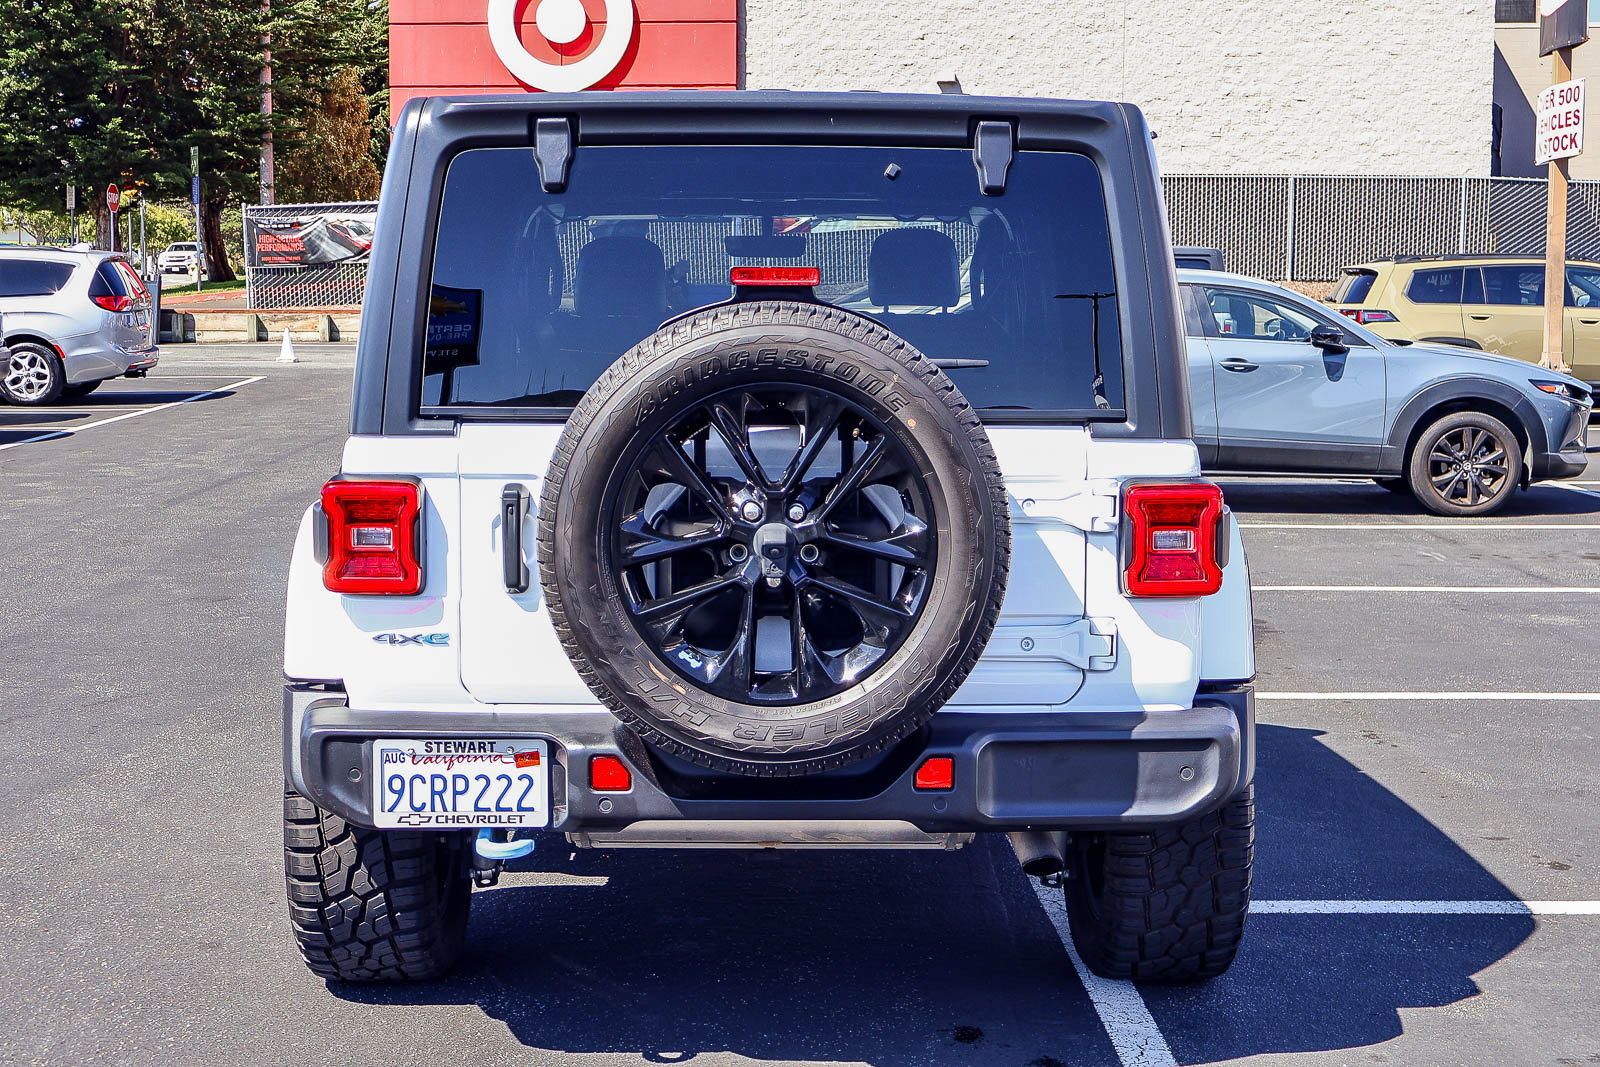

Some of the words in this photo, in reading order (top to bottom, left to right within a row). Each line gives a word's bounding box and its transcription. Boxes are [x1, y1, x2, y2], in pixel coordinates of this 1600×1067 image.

[1559, 86, 1580, 105] 500
[107, 191, 119, 203] STOP
[634, 348, 910, 426] BRIDGESTONE
[633, 664, 713, 728] H/L
[732, 649, 932, 742] DUELER
[424, 741, 497, 753] STEWART
[384, 752, 406, 764] AUG
[411, 753, 515, 770] California
[387, 774, 535, 812] 9CRP222
[435, 814, 526, 824] CHEVROLET
